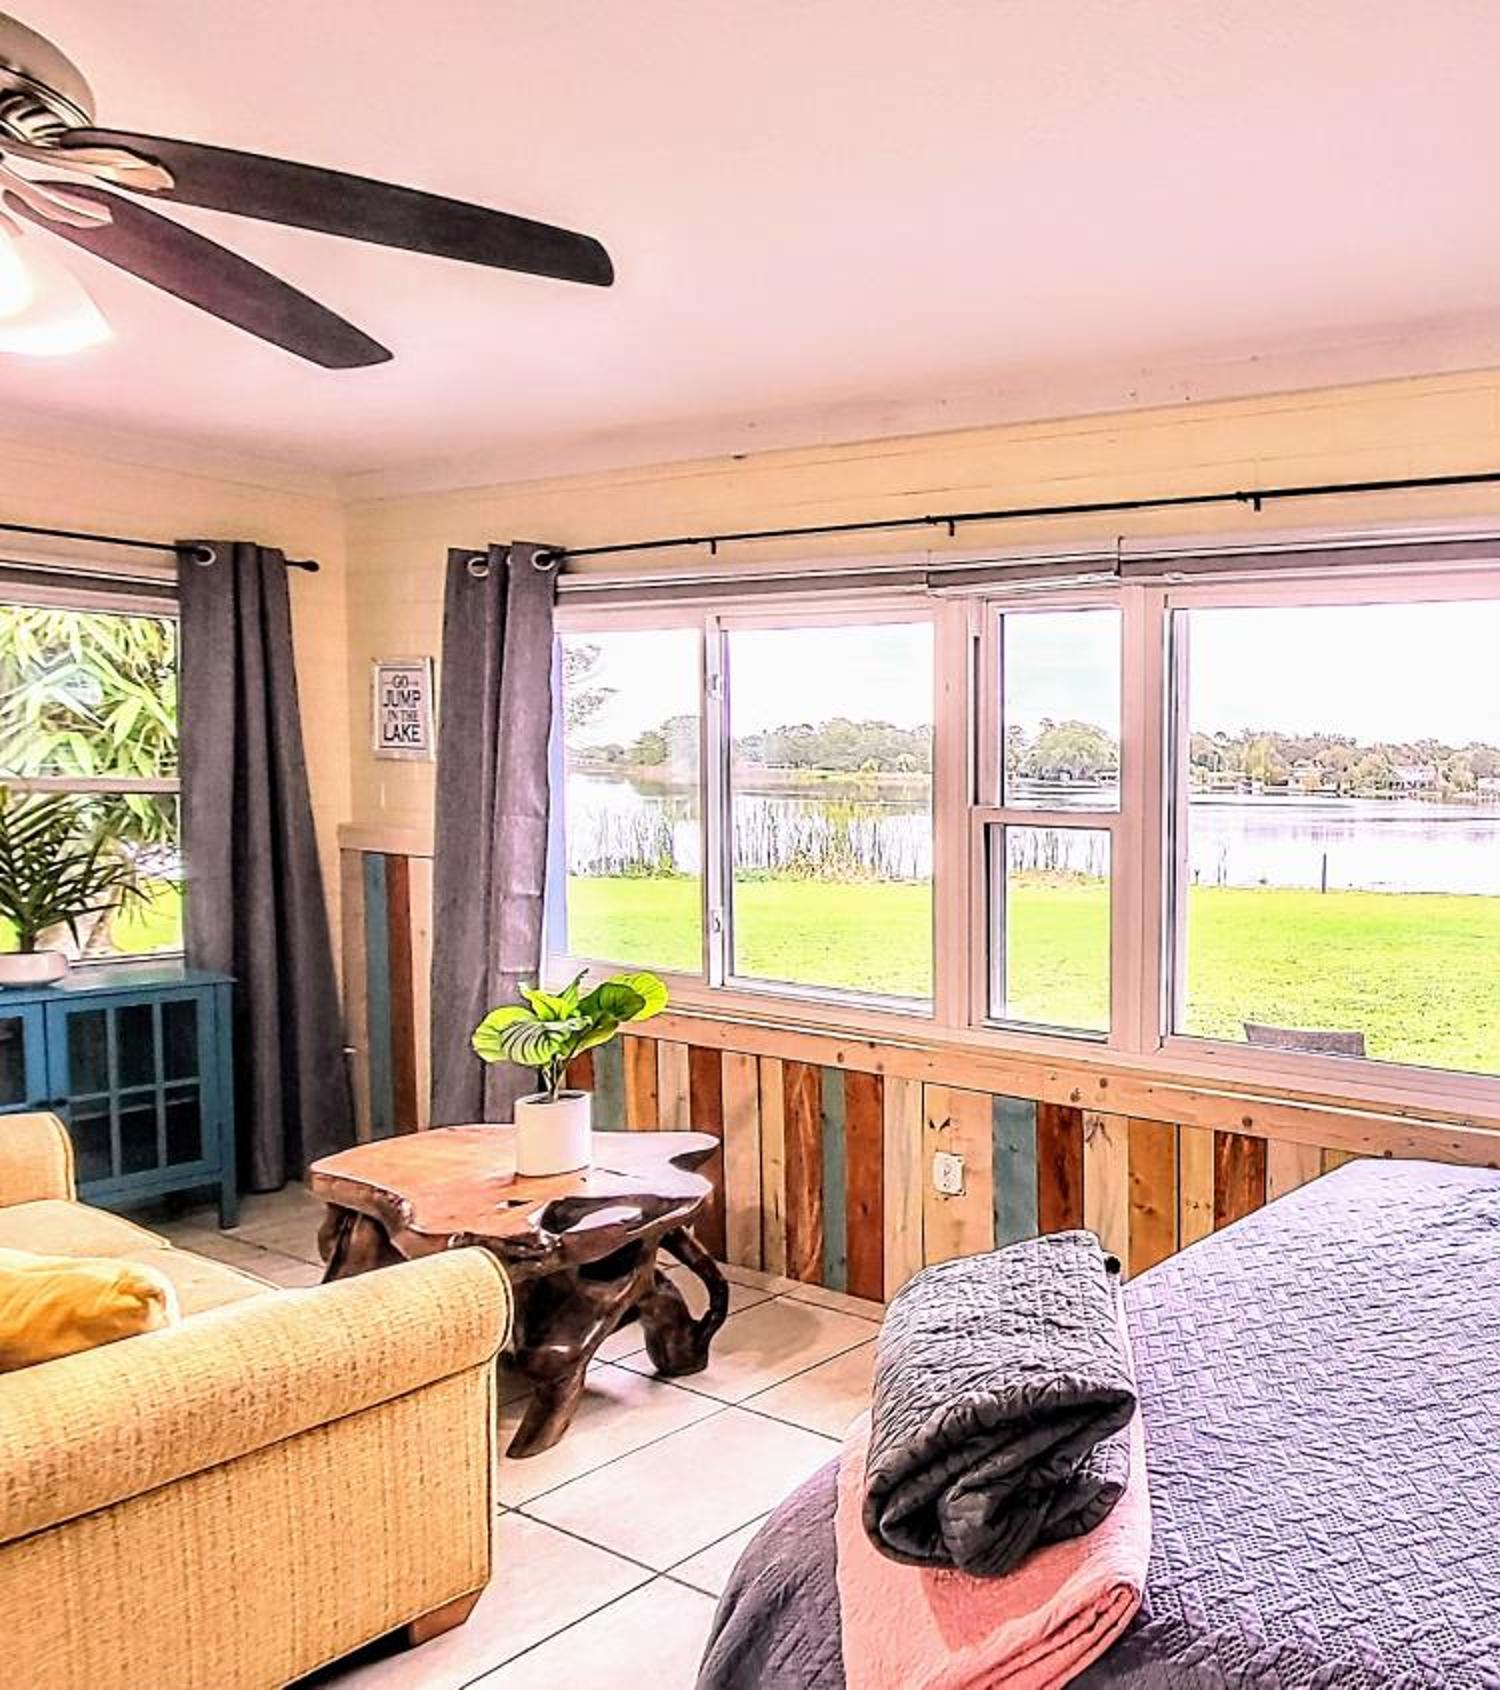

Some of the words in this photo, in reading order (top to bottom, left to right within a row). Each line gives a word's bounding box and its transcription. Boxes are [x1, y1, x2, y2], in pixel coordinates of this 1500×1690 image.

[392, 675, 409, 688] GO
[383, 690, 421, 708] JUMP
[388, 710, 399, 722] IN
[400, 710, 419, 722] THE
[383, 724, 421, 742] LAKE
